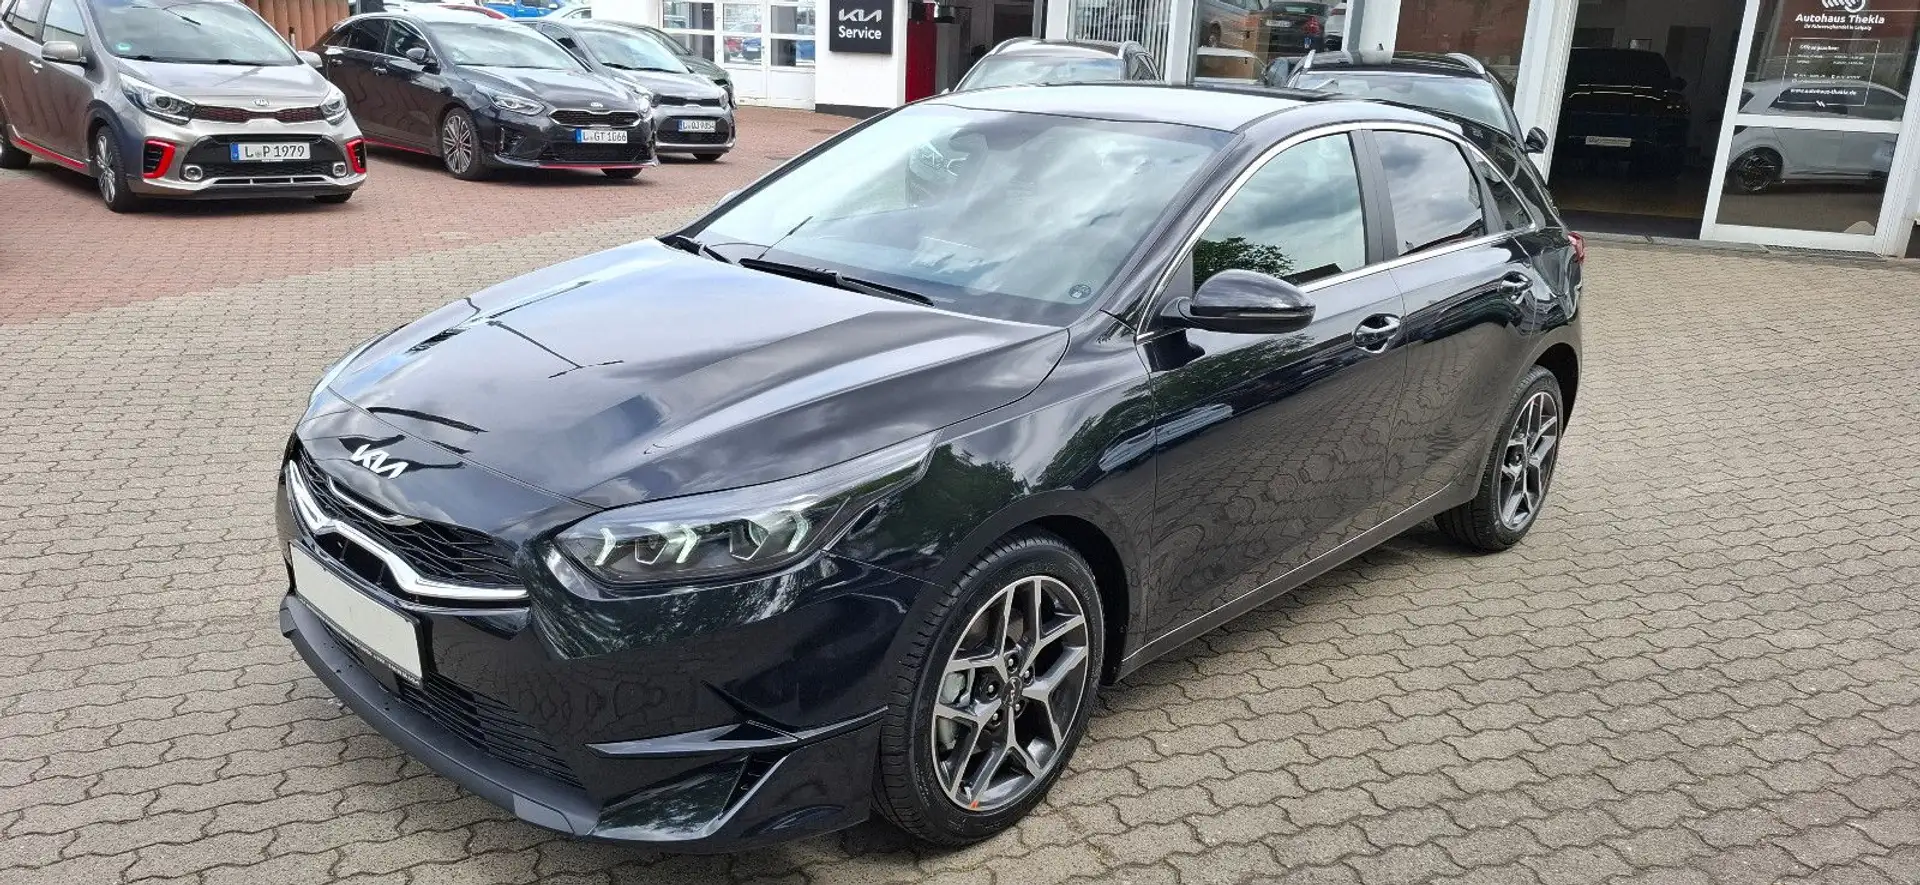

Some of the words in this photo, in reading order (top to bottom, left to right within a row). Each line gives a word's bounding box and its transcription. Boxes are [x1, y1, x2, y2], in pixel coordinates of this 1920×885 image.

[838, 8, 882, 22] KIA
[1795, 13, 1846, 23] Autohaus
[1848, 14, 1885, 24] Thekla
[838, 25, 882, 40] Service
[594, 131, 605, 141] GT
[607, 132, 627, 142] 1066
[245, 146, 253, 158] L
[262, 145, 270, 157] P
[274, 145, 305, 157] 1979
[350, 443, 410, 480] KIA
